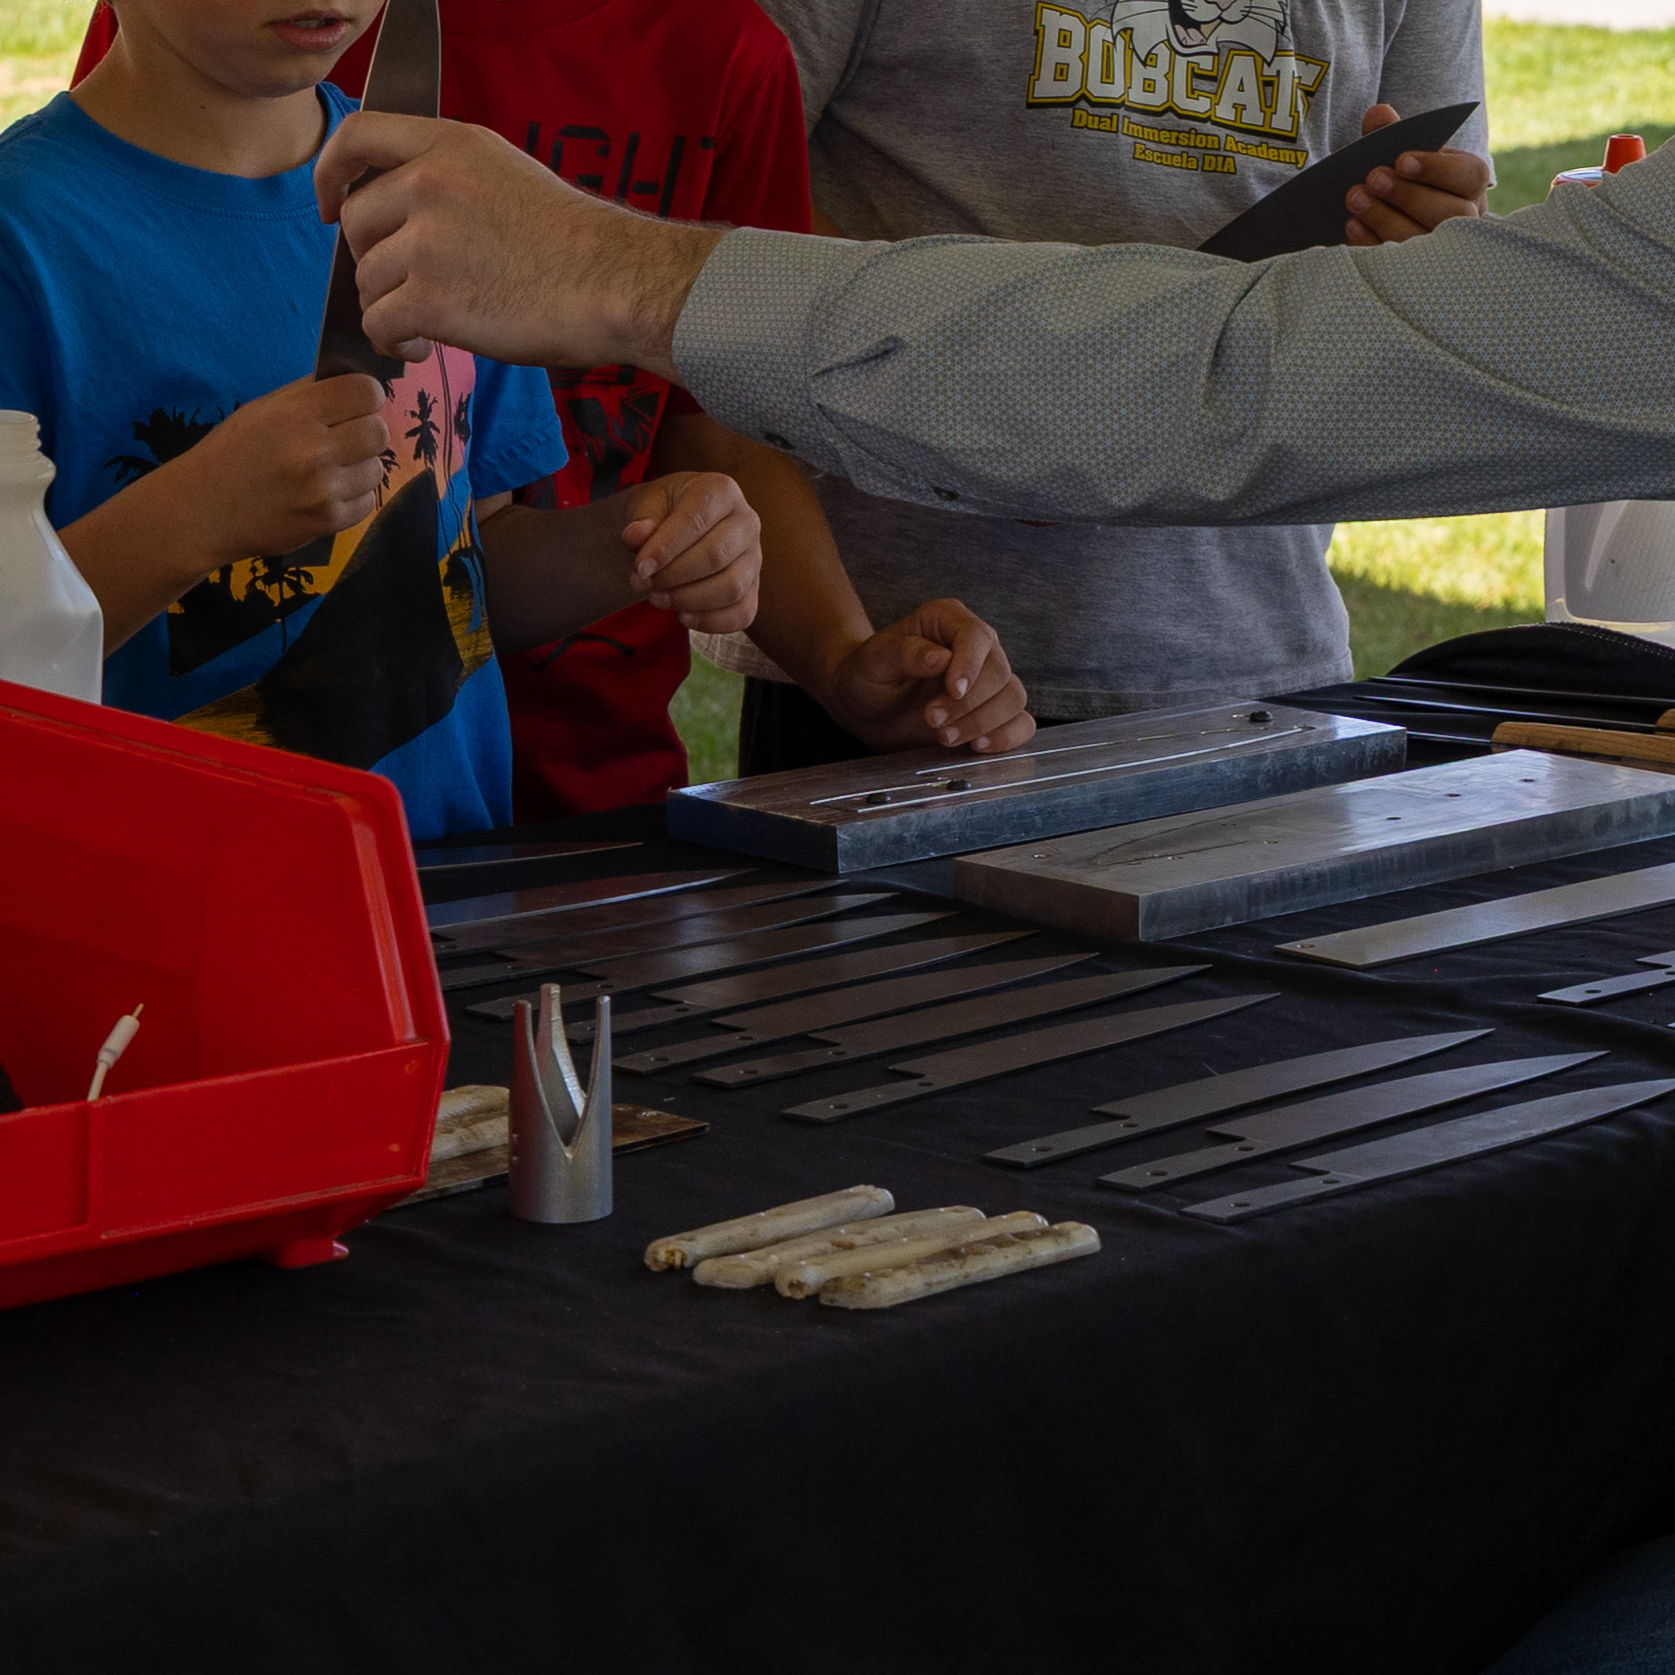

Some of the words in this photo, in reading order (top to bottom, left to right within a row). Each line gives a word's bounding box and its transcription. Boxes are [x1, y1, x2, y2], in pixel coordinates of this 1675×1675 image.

[1071, 109, 1118, 134] Dual
[1122, 116, 1221, 151] Immersion
[1223, 134, 1310, 170] Academy
[1133, 142, 1200, 171] Escuela
[1202, 154, 1238, 175] DIA
